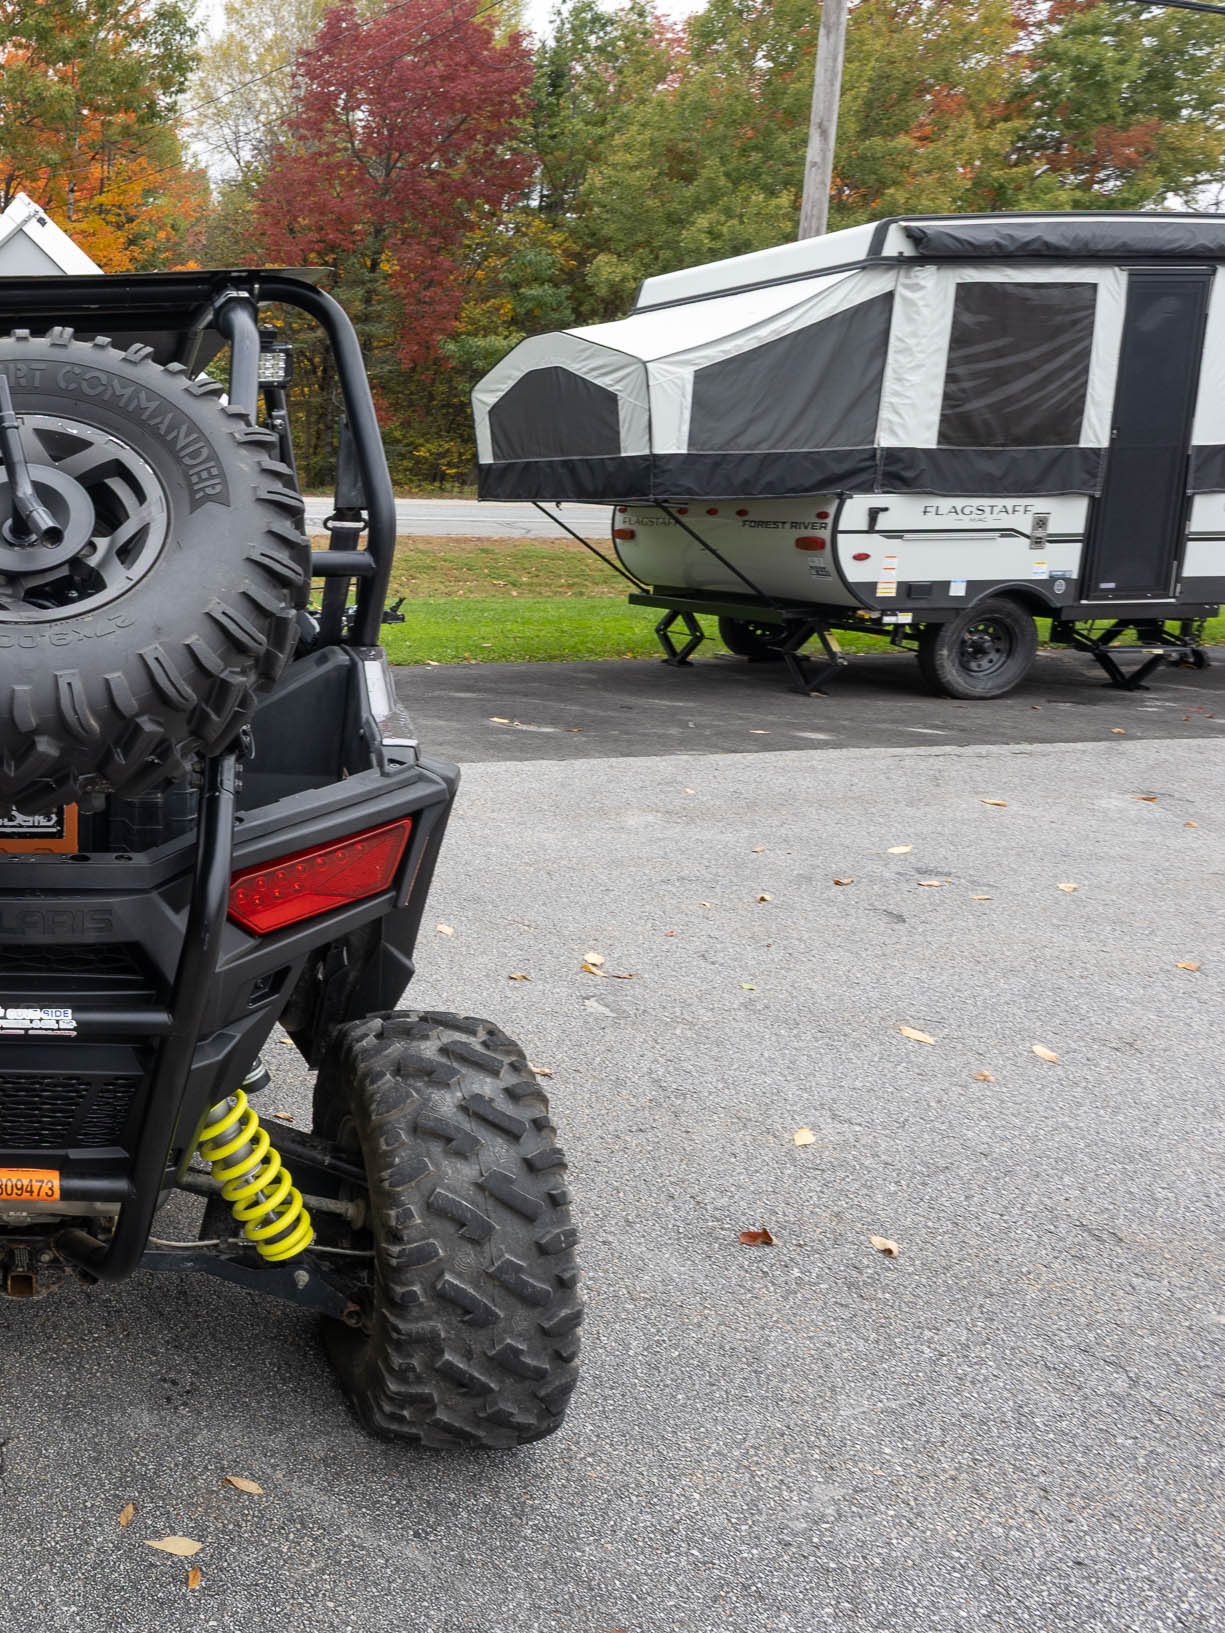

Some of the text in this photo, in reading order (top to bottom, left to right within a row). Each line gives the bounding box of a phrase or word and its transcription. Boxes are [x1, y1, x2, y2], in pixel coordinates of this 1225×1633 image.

[56, 365, 224, 500] COMMANDER
[922, 504, 1035, 516] FLAGSTAFF
[741, 519, 829, 531] FOREST RIVER
[42, 1009, 69, 1018] SIDE
